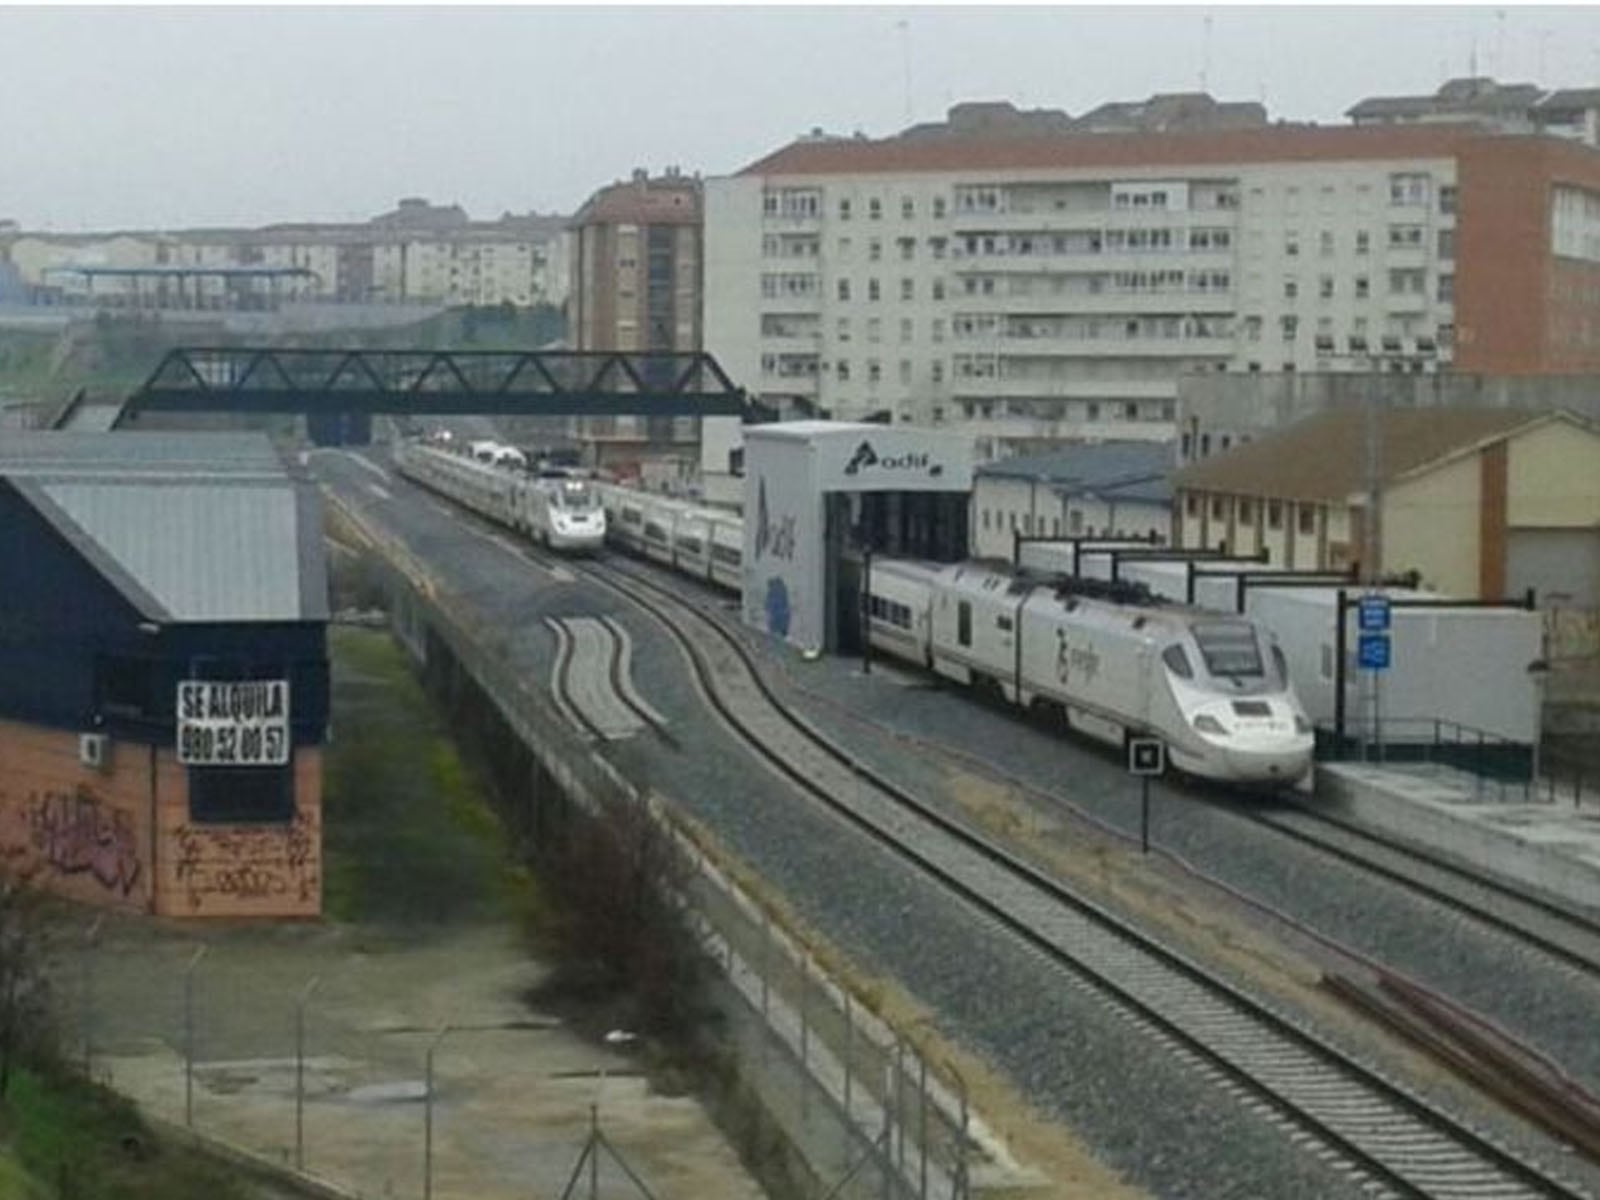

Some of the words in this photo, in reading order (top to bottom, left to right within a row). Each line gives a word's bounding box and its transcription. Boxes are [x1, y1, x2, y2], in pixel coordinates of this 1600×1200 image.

[183, 685, 204, 718] SE
[209, 684, 283, 721] ALQUILA
[217, 726, 237, 759] 52
[267, 726, 284, 759] 57
